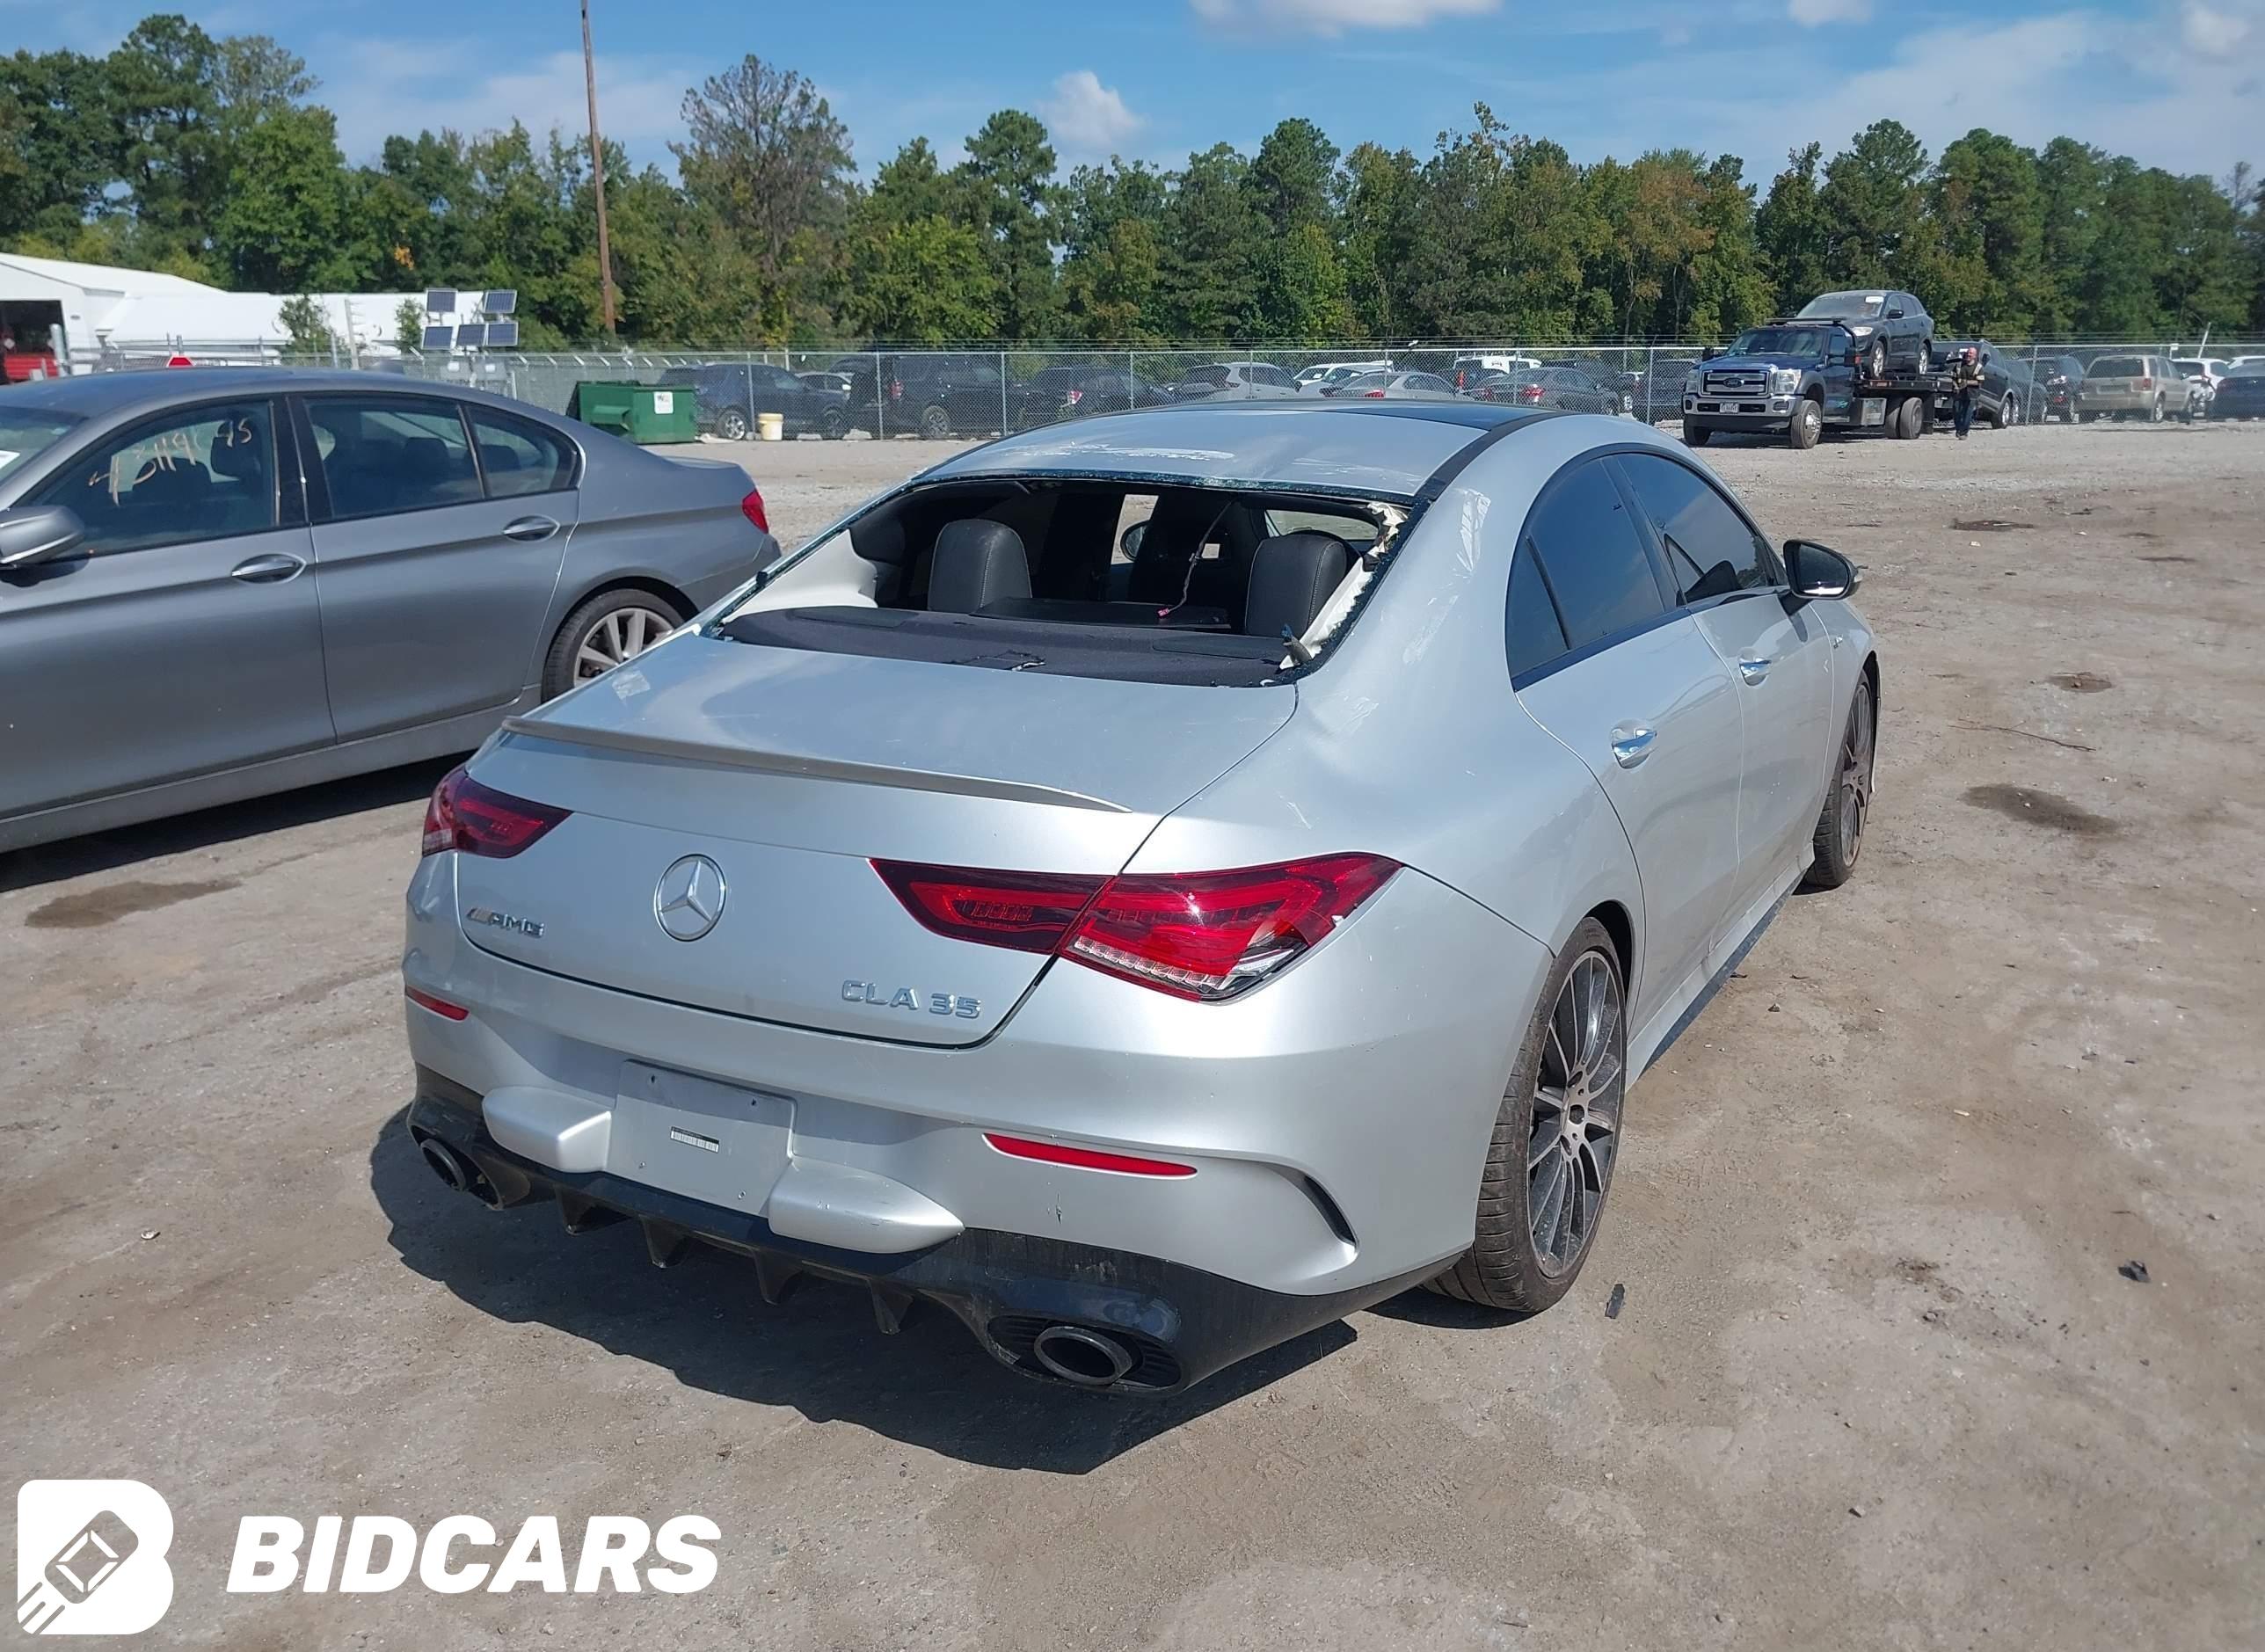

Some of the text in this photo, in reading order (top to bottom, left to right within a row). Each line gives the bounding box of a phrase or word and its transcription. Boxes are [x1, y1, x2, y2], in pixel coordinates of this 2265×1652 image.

[485, 910, 544, 938] AMG
[841, 979, 982, 1019] CLA 35
